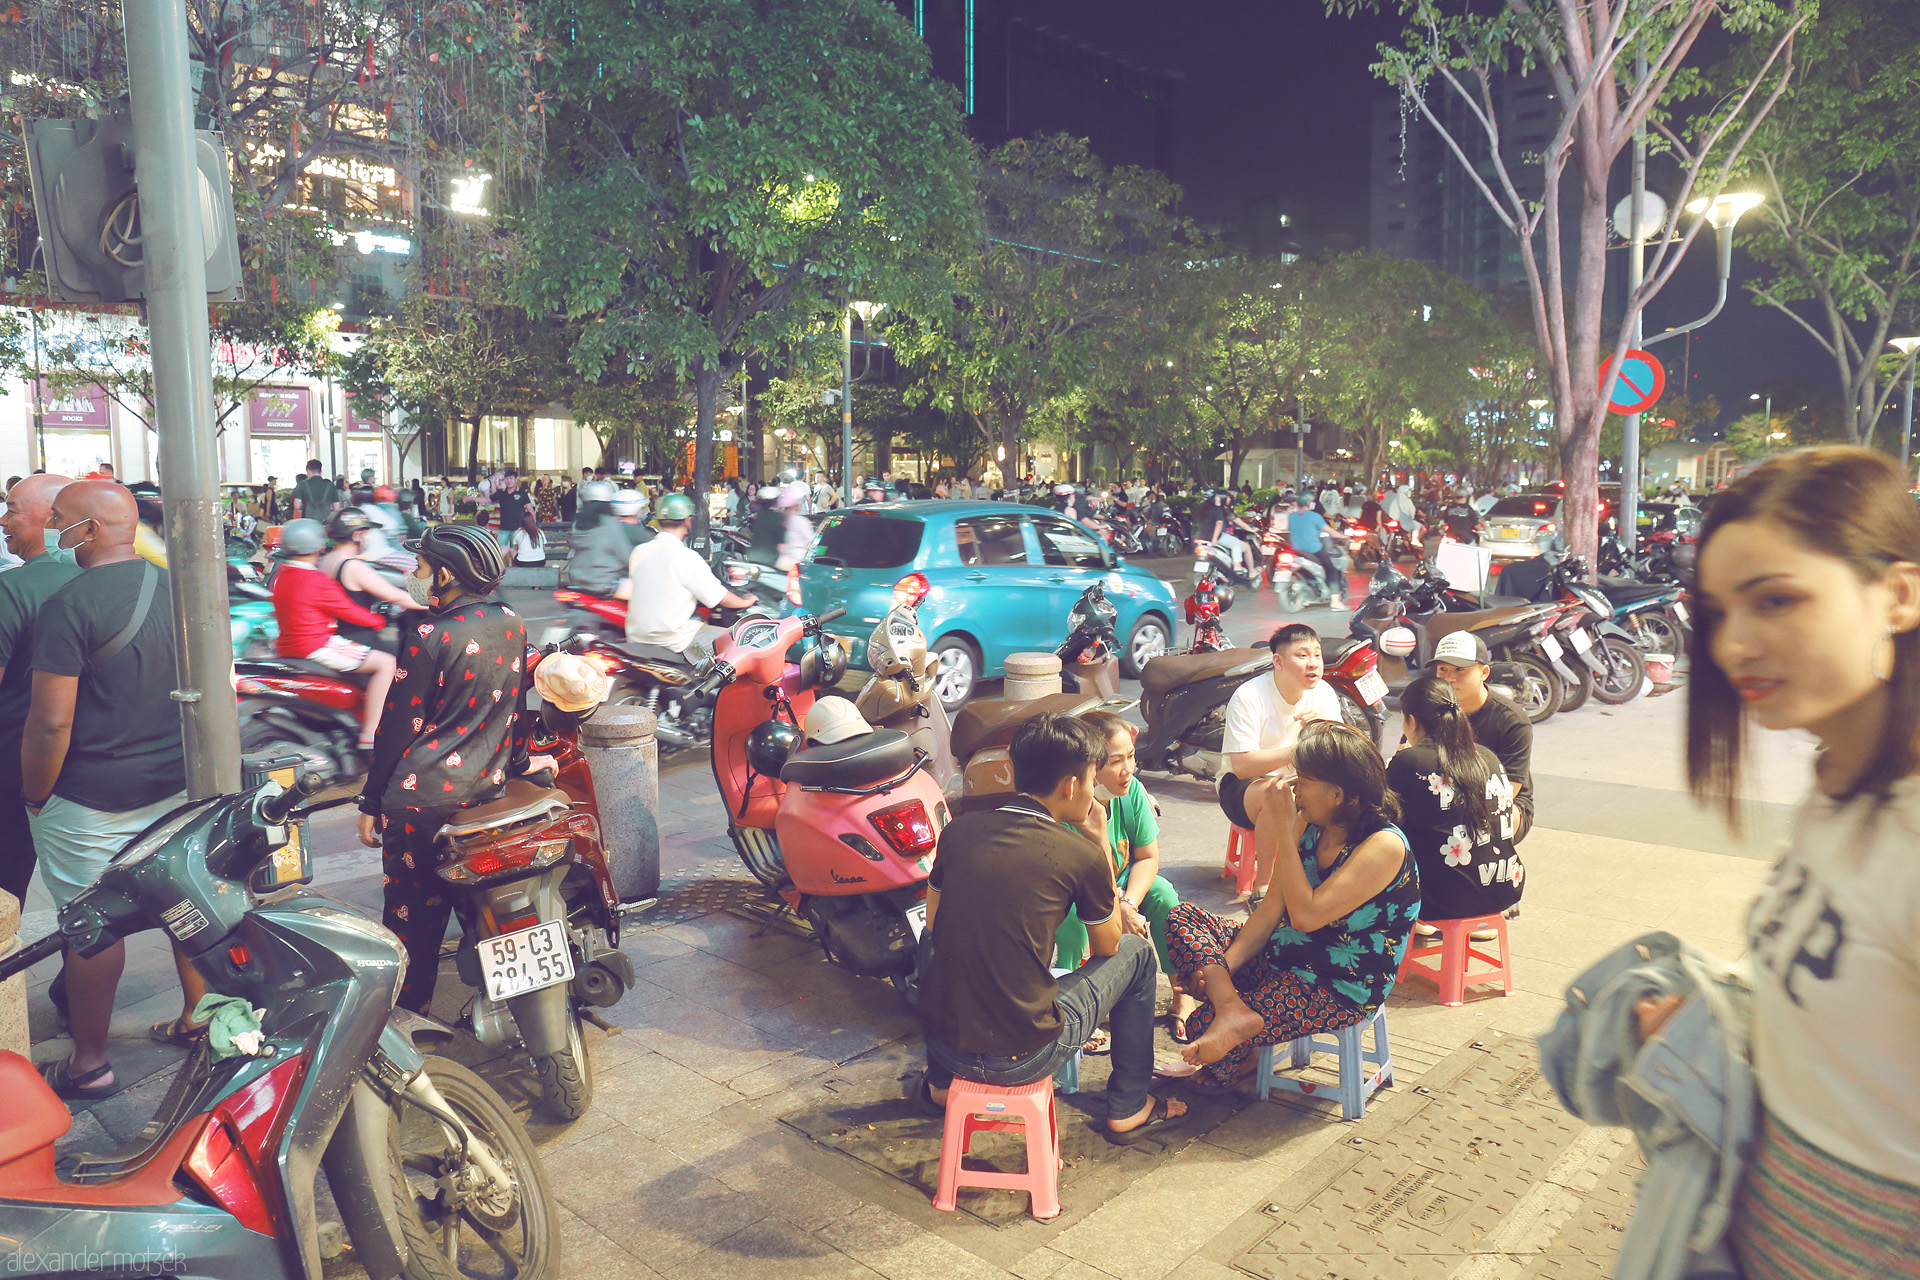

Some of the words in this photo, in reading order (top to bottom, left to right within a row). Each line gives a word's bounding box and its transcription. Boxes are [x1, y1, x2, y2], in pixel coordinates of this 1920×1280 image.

[830, 868, 868, 884] Vespa
[491, 928, 553, 966] 59-C3
[356, 959, 394, 968] HONDA
